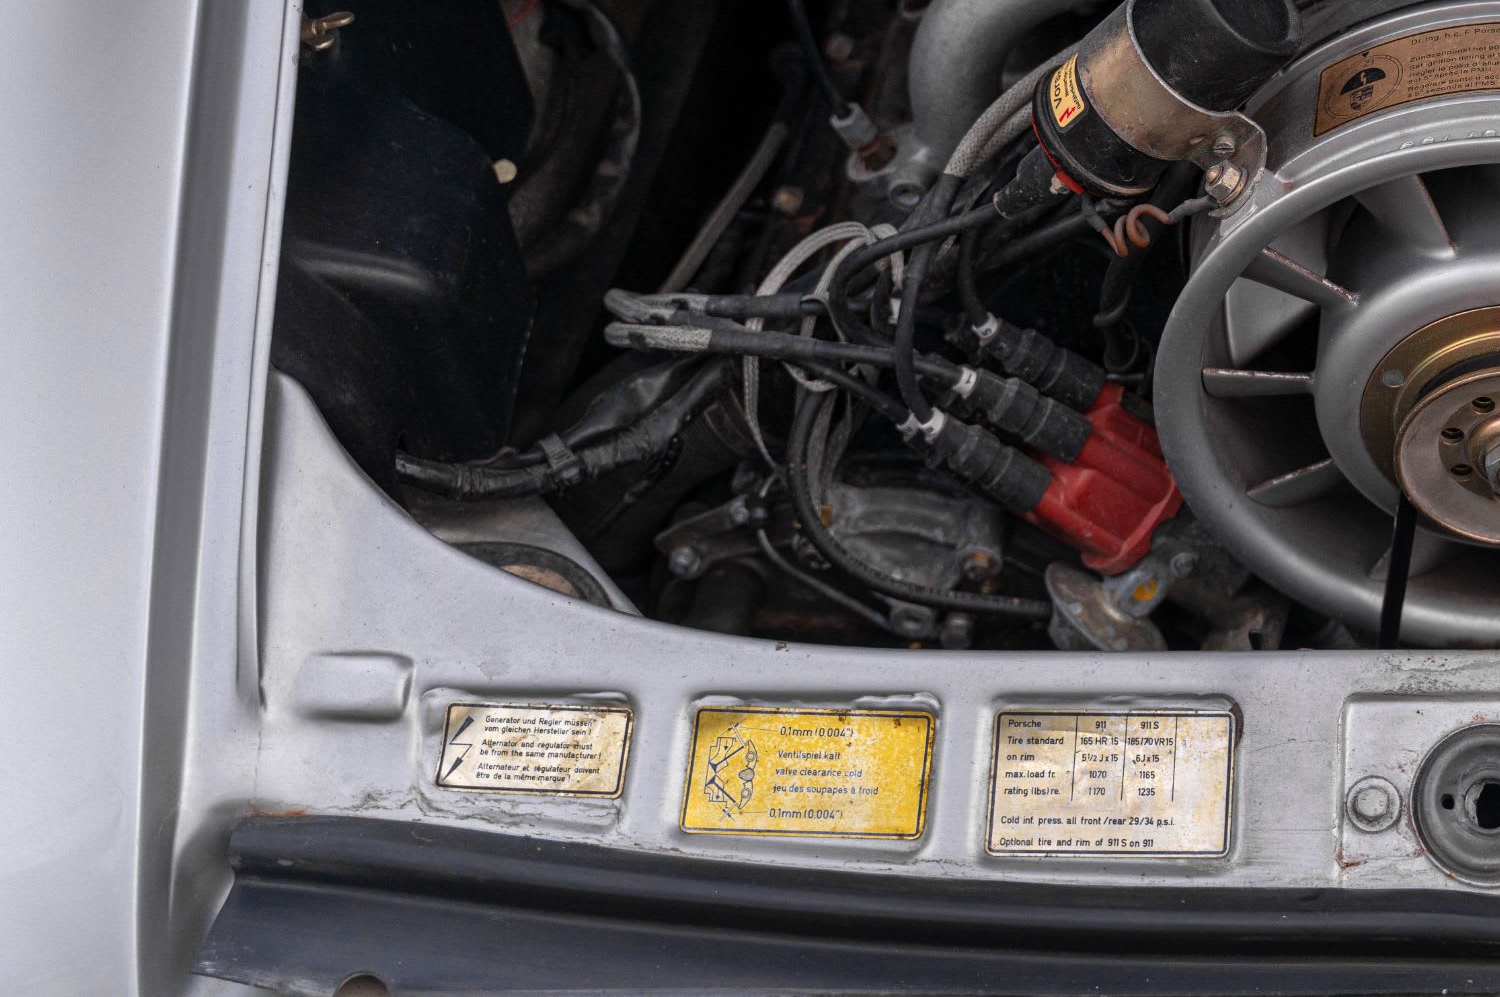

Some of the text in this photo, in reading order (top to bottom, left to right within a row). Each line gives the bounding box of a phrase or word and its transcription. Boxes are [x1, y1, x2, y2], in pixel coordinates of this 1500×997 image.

[485, 716, 593, 726] Generator und Regler müssen
[1095, 721, 1106, 729] 911
[501, 726, 531, 734] gleichen
[534, 727, 569, 735] Hersteller
[482, 739, 517, 747] Alternator
[1008, 736, 1023, 744] Tire
[1080, 737, 1093, 745] 165
[1095, 737, 1107, 745] HR
[1111, 737, 1119, 745] 15
[778, 750, 841, 760] Ventilspiel kalt
[1020, 753, 1035, 761] rim
[477, 763, 520, 771] Alternateur
[534, 765, 570, 773] régulateur
[574, 766, 600, 774] doivent
[800, 768, 841, 776] clearance
[844, 770, 862, 778] cold
[504, 772, 511, 780] la
[514, 773, 536, 781] même
[1027, 770, 1045, 778] load
[1139, 771, 1155, 779] 1165
[773, 785, 787, 793] jeu
[789, 784, 804, 792] des
[806, 786, 848, 795] soupapes
[859, 787, 879, 795] froid
[1004, 787, 1028, 797] rating
[1088, 787, 1106, 795] 1170
[1138, 788, 1155, 796] 1235
[1001, 816, 1020, 824] Cold
[1023, 816, 1035, 824] inf.
[1038, 817, 1063, 826] press.
[1066, 816, 1077, 825] all
[1080, 817, 1101, 825] front
[1129, 817, 1154, 825] 29/34
[1000, 838, 1034, 847] Optional
[1038, 838, 1052, 846] tire
[1056, 838, 1072, 846] and
[1075, 838, 1091, 847] rim
[1095, 838, 1103, 847] of
[1143, 839, 1154, 847] 911
